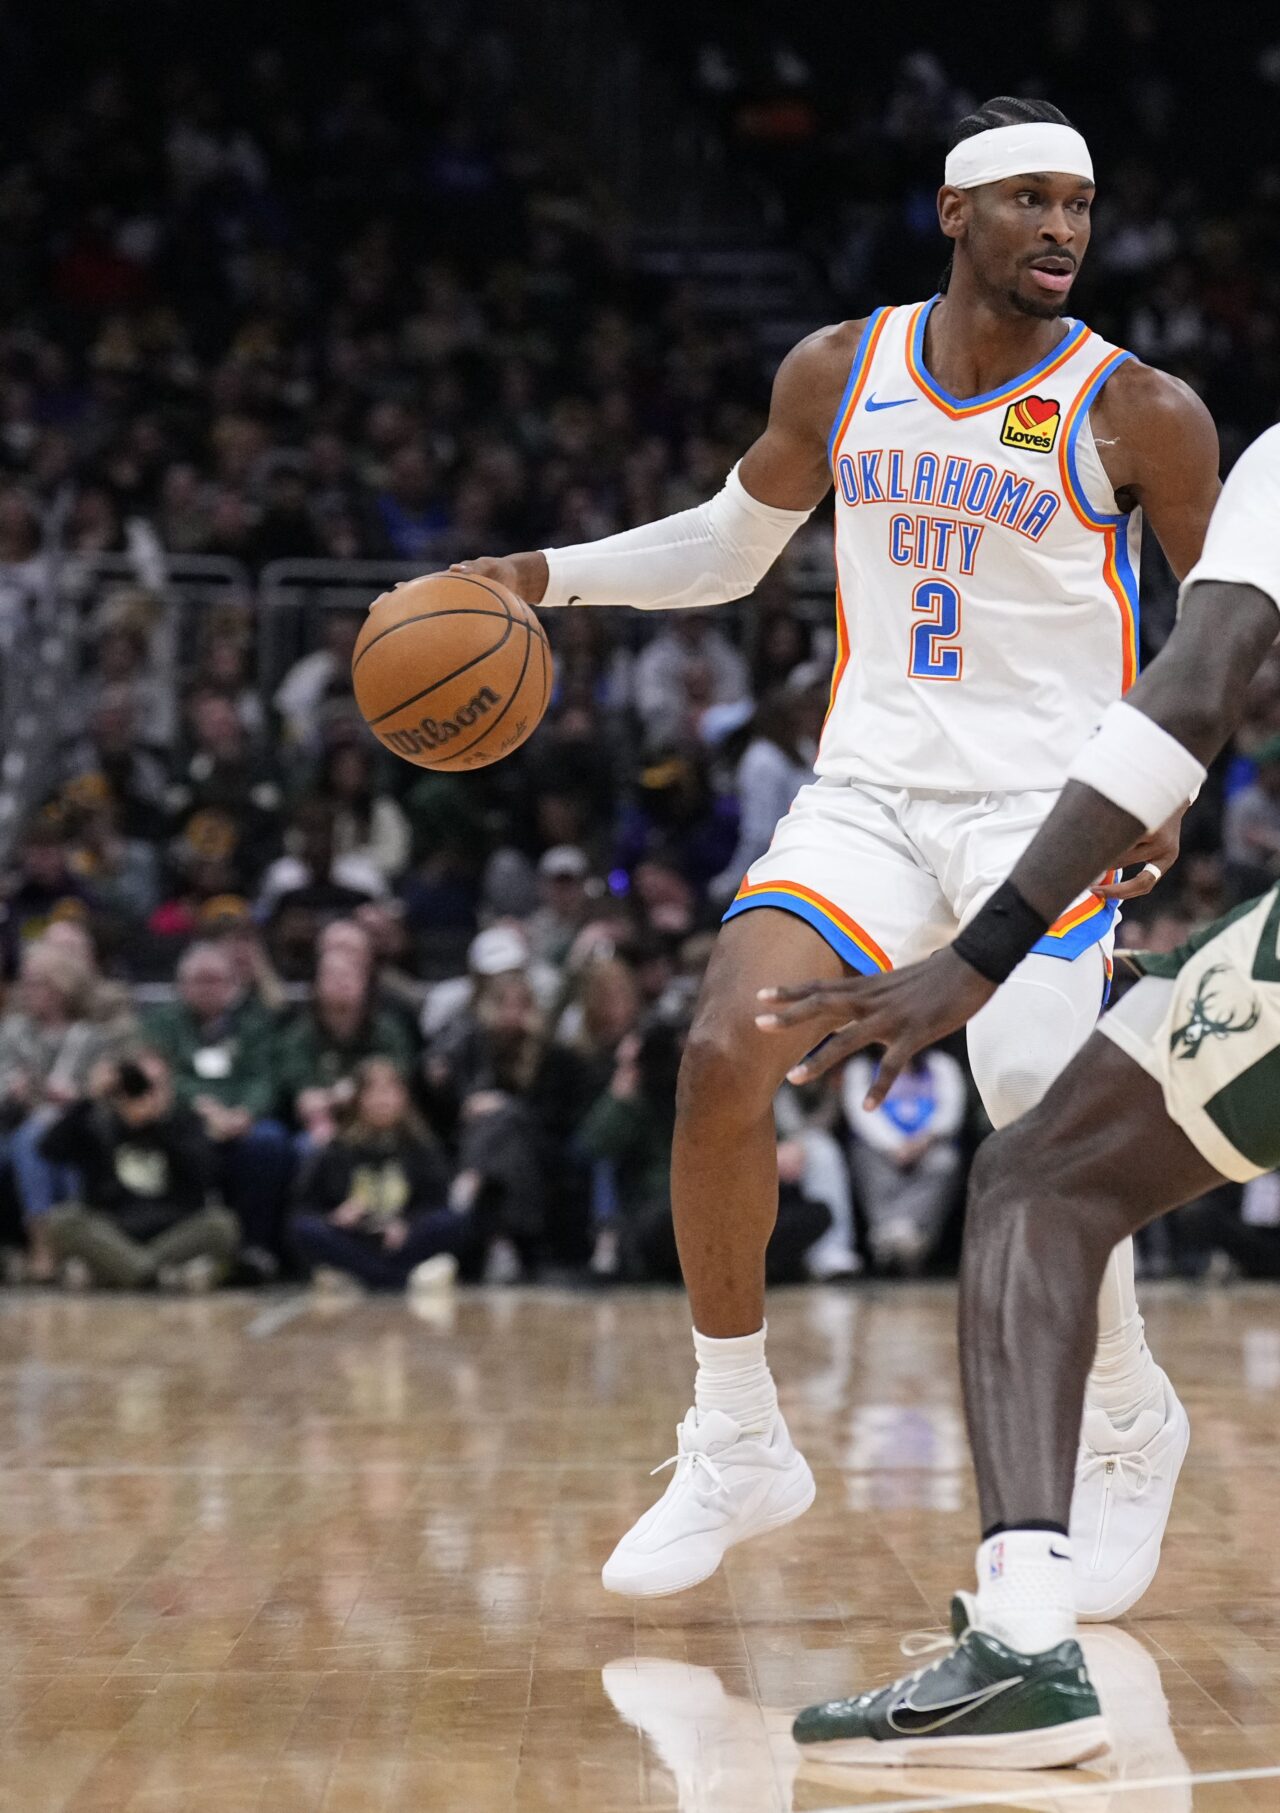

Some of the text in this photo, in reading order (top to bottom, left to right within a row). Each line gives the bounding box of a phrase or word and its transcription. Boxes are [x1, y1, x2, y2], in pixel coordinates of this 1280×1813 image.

[838, 450, 1061, 542] OKLAHOMA
[889, 513, 984, 576] CITY
[908, 578, 962, 681] 2
[382, 685, 502, 755] Wilson
